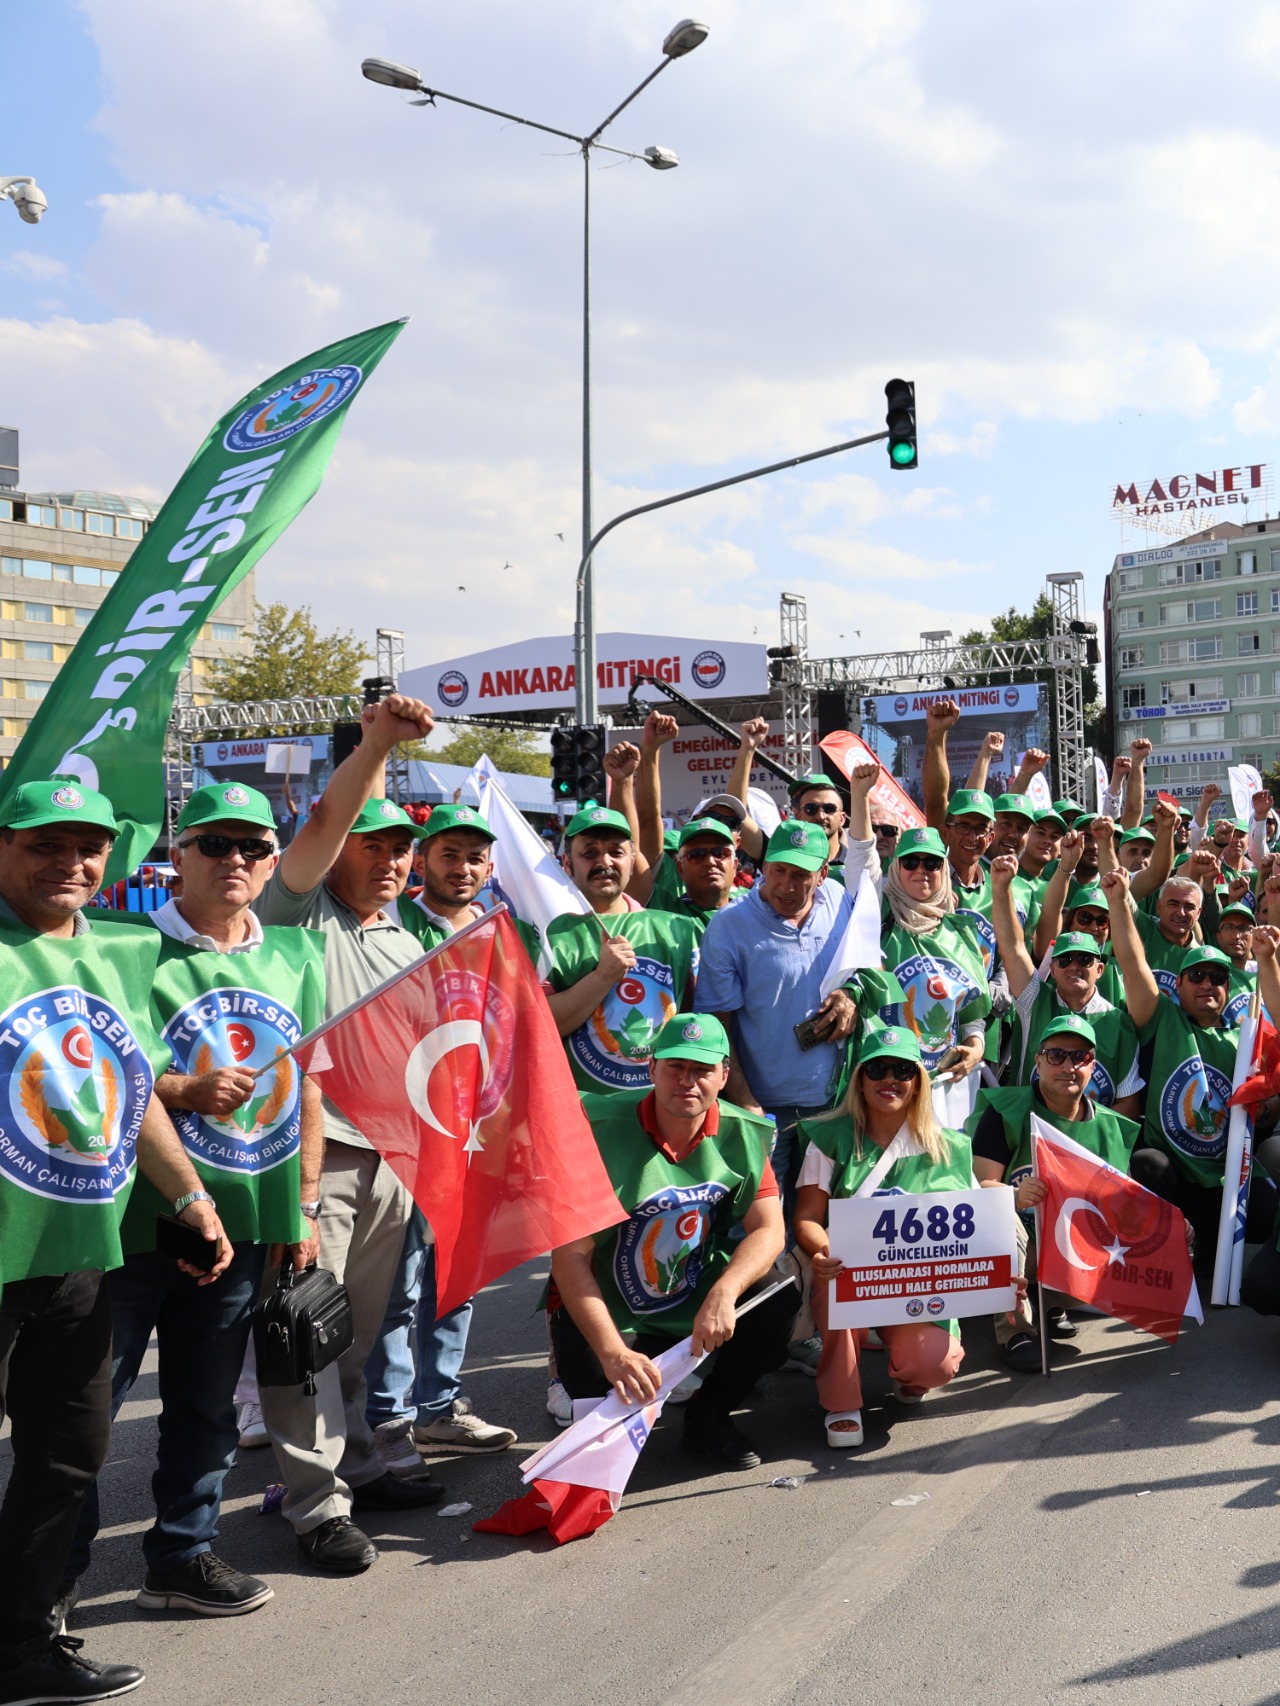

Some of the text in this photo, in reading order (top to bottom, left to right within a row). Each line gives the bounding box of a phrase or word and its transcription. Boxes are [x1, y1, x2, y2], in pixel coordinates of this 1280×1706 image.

[1113, 463, 1266, 507] MAGNET
[479, 665, 576, 698] ANKARA
[231, 742, 265, 757] ANKARA
[1181, 752, 1225, 762] SİGORTA
[976, 921, 996, 944] -SEN
[896, 961, 923, 983] TOÇ
[0, 1007, 47, 1048] TOÇ
[172, 993, 301, 1045] TOÇ BİR-SEN
[577, 1040, 651, 1083] ORMAN ÇALIŞANL
[631, 1045, 651, 1055] 2001
[1183, 1061, 1204, 1076] TO
[1166, 1082, 1180, 1105] TARIM
[122, 1072, 146, 1149] SENDİKASI
[88, 1134, 104, 1147] 20
[872, 1203, 975, 1245] 4688
[620, 1221, 638, 1294] TARIM ORMAN
[878, 1240, 968, 1263] GÜNCELLENSİN
[852, 1260, 995, 1283] ULUSLARARASI NORMLARA
[856, 1283, 902, 1298] UYUMLU
[906, 1280, 932, 1293] HALE
